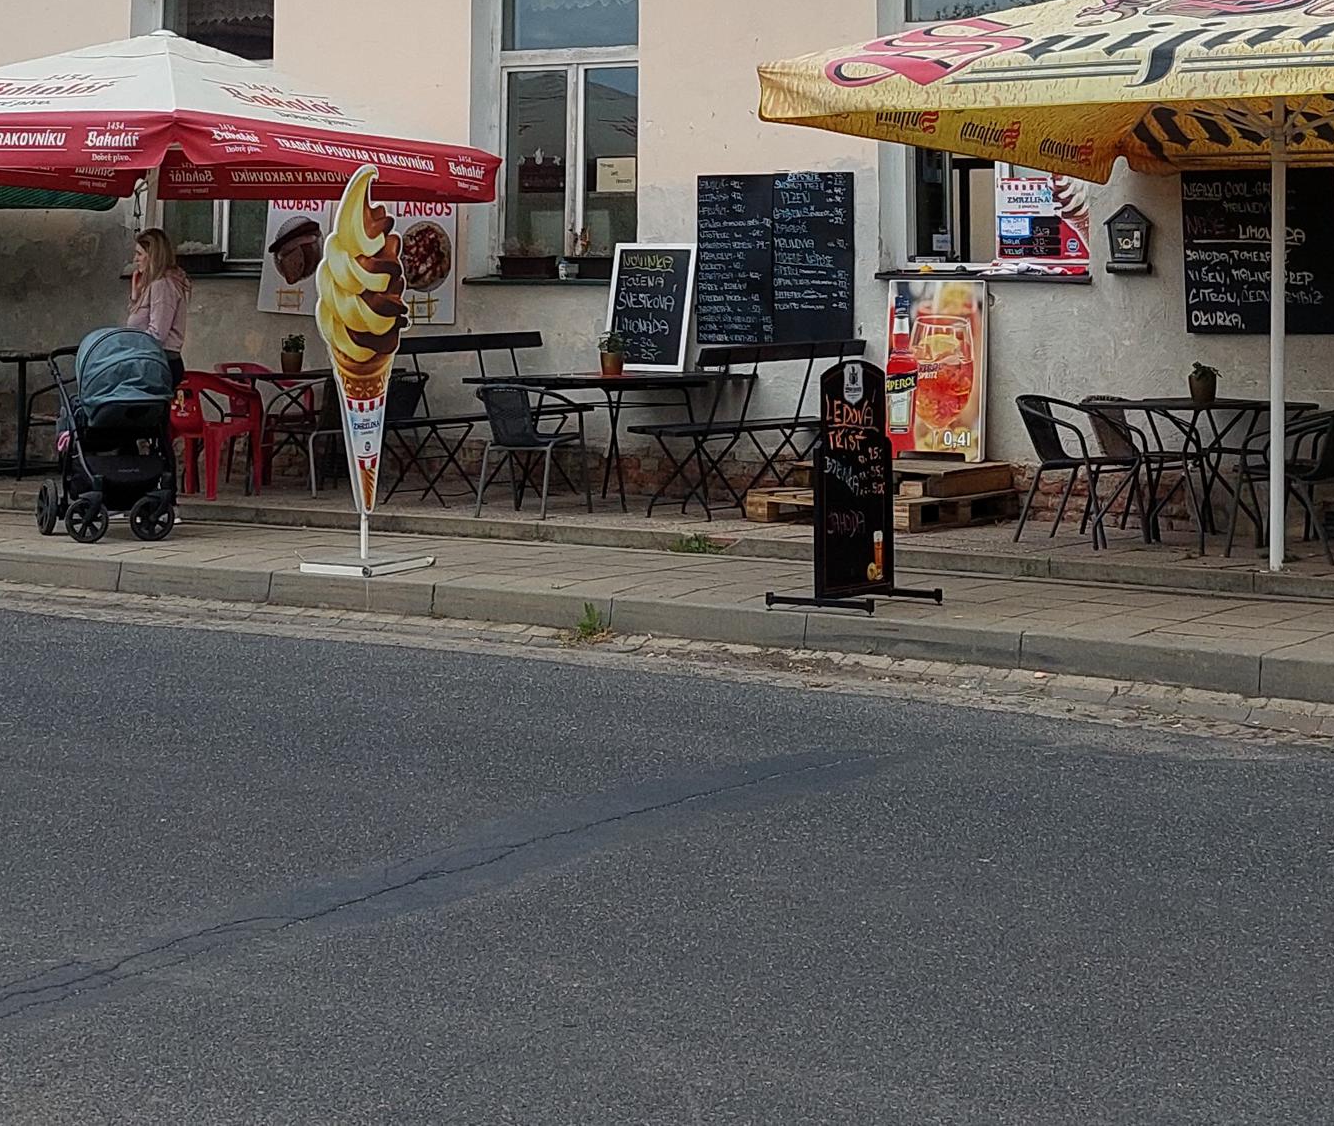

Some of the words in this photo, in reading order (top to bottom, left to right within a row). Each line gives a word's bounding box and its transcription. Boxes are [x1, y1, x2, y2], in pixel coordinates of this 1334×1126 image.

[84, 131, 139, 147] Bakalář
[274, 137, 327, 156] TRADIČNÍ
[327, 145, 370, 162] PIVOVAR
[371, 152, 380, 163] V
[380, 153, 435, 172] RAKOVNÍKU
[449, 162, 485, 180] Bakalář
[623, 253, 674, 268] NOVINKA
[620, 273, 665, 287] TOČENÁ
[616, 284, 677, 312] ŠVESTKOVÁ
[615, 312, 669, 334] LIMONÁDA
[886, 375, 916, 393] APEROL
[825, 389, 876, 426] LEDOVÁ
